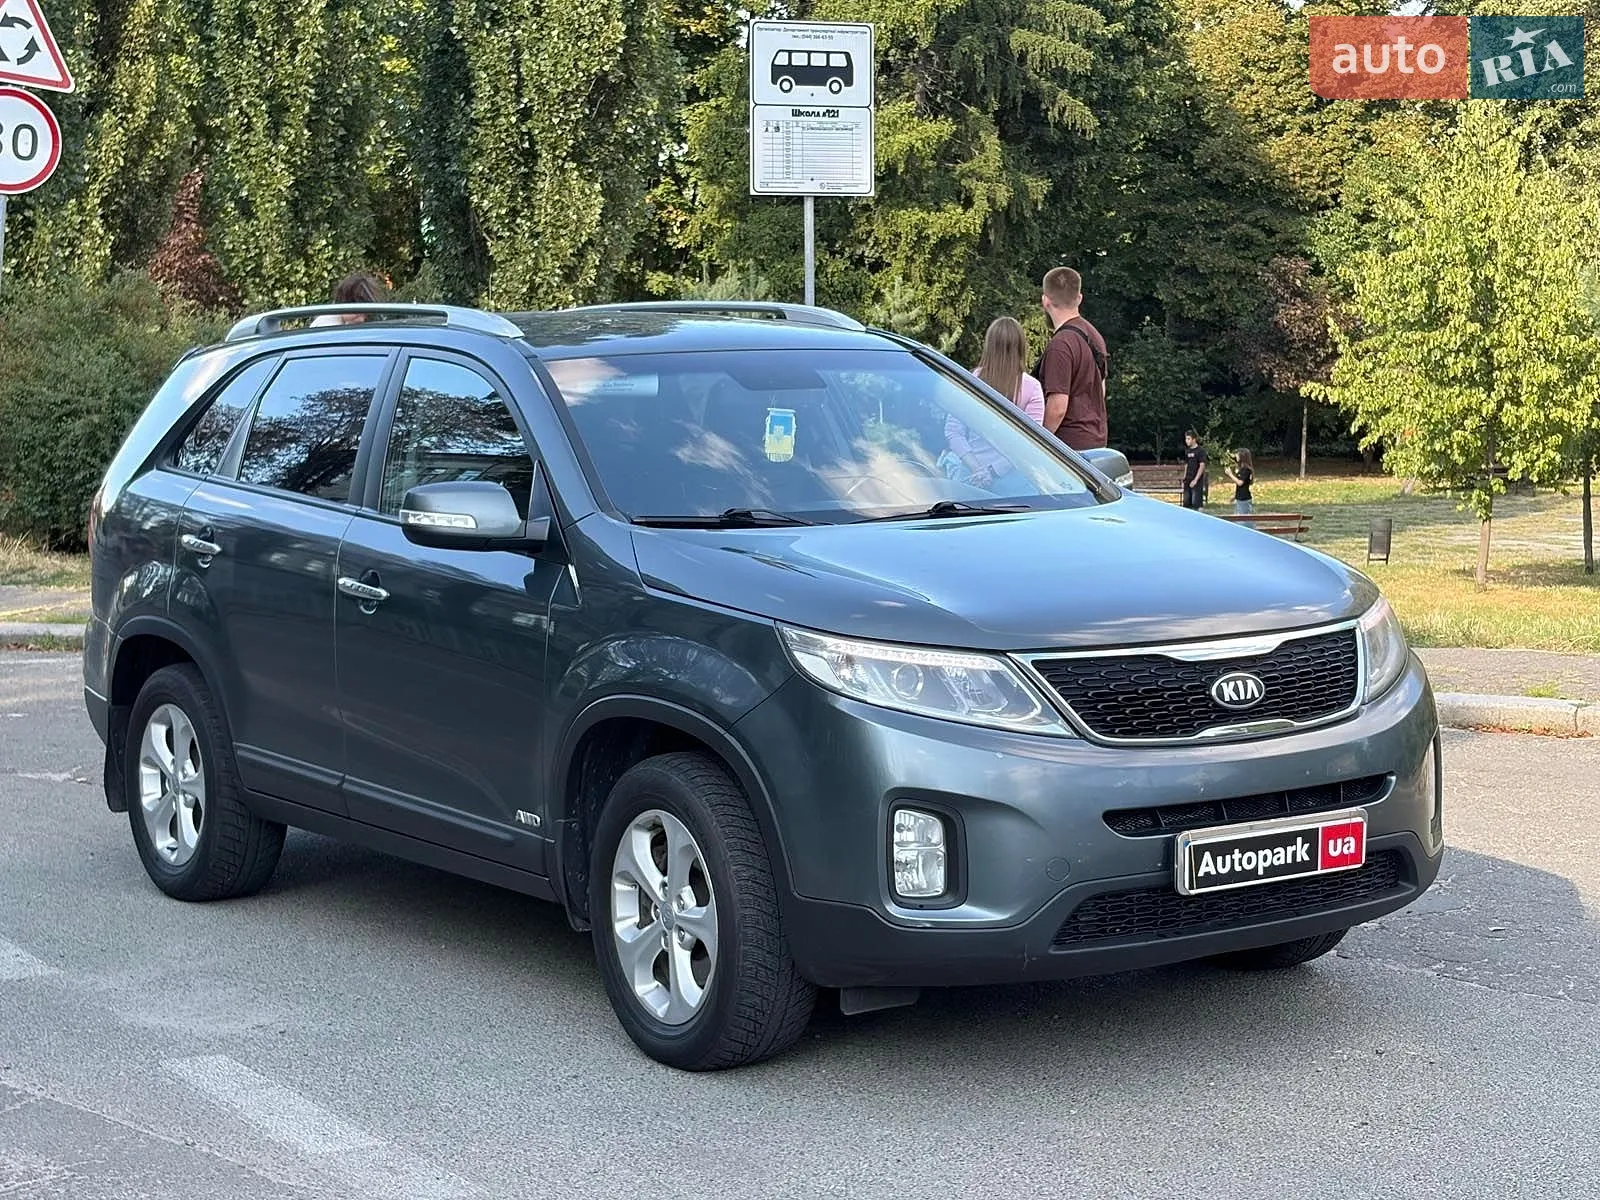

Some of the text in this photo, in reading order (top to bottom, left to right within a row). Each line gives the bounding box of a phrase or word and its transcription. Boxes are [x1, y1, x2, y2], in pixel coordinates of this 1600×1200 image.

[0, 122, 39, 161] 0
[1220, 679, 1260, 702] KIA
[1198, 835, 1355, 876] Autopark ua
